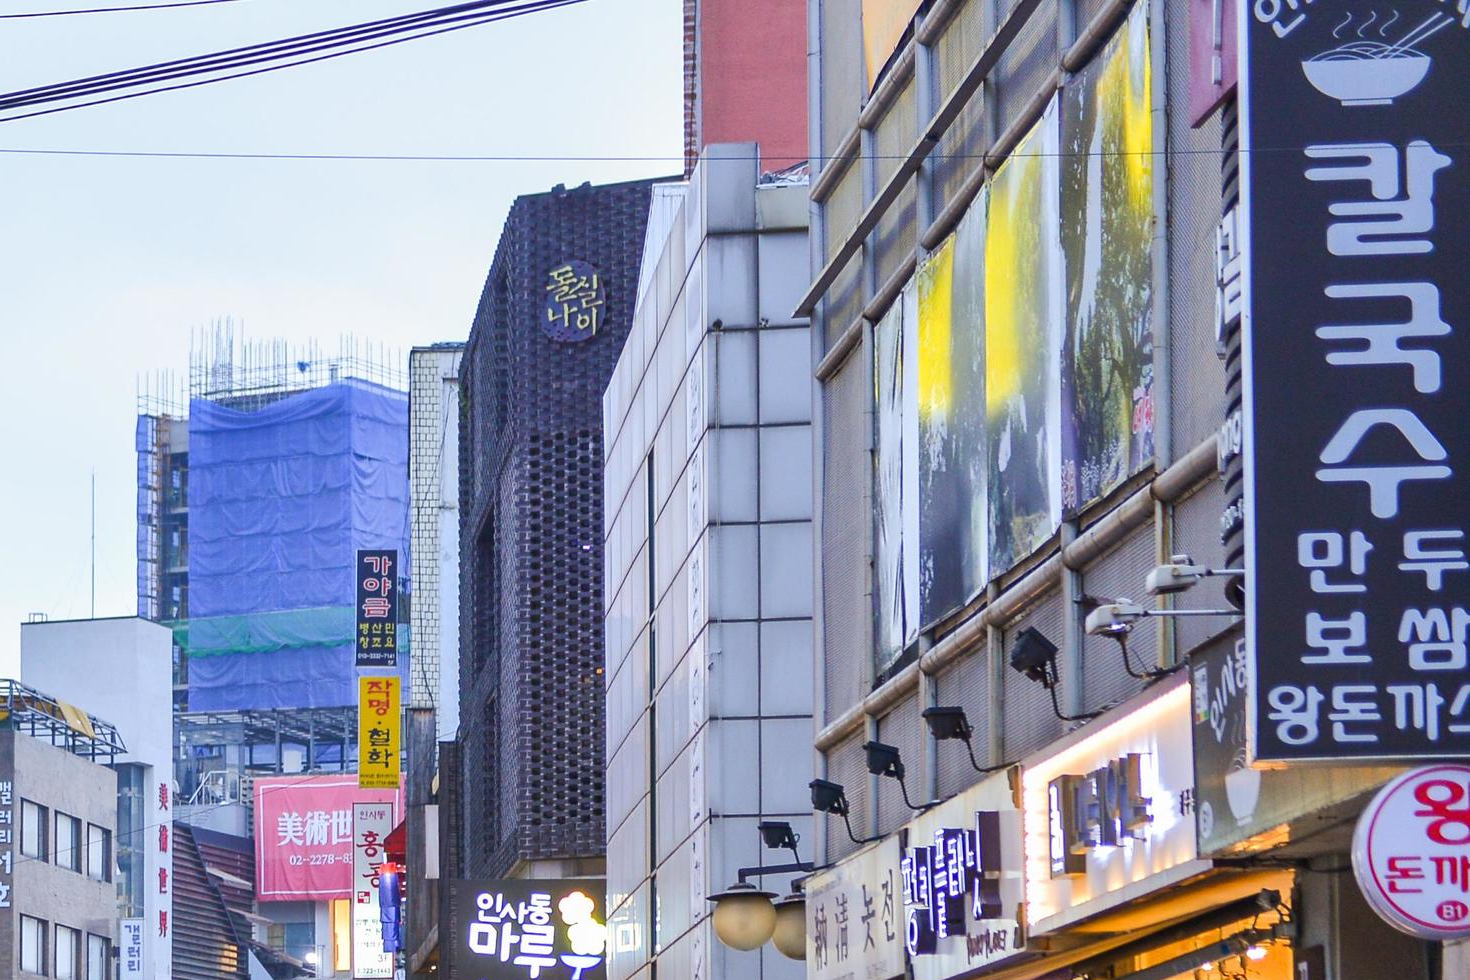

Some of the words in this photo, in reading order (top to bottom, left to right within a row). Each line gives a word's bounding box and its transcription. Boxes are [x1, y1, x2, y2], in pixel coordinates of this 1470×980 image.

[1303, 140, 1454, 519] 칼국수
[361, 556, 393, 618] 가야금
[1297, 530, 1470, 594] 만두
[1300, 607, 1470, 671] 보쌈
[476, 891, 553, 925] 인사동
[1441, 904, 1463, 919] B1
[467, 921, 558, 979] 마루
